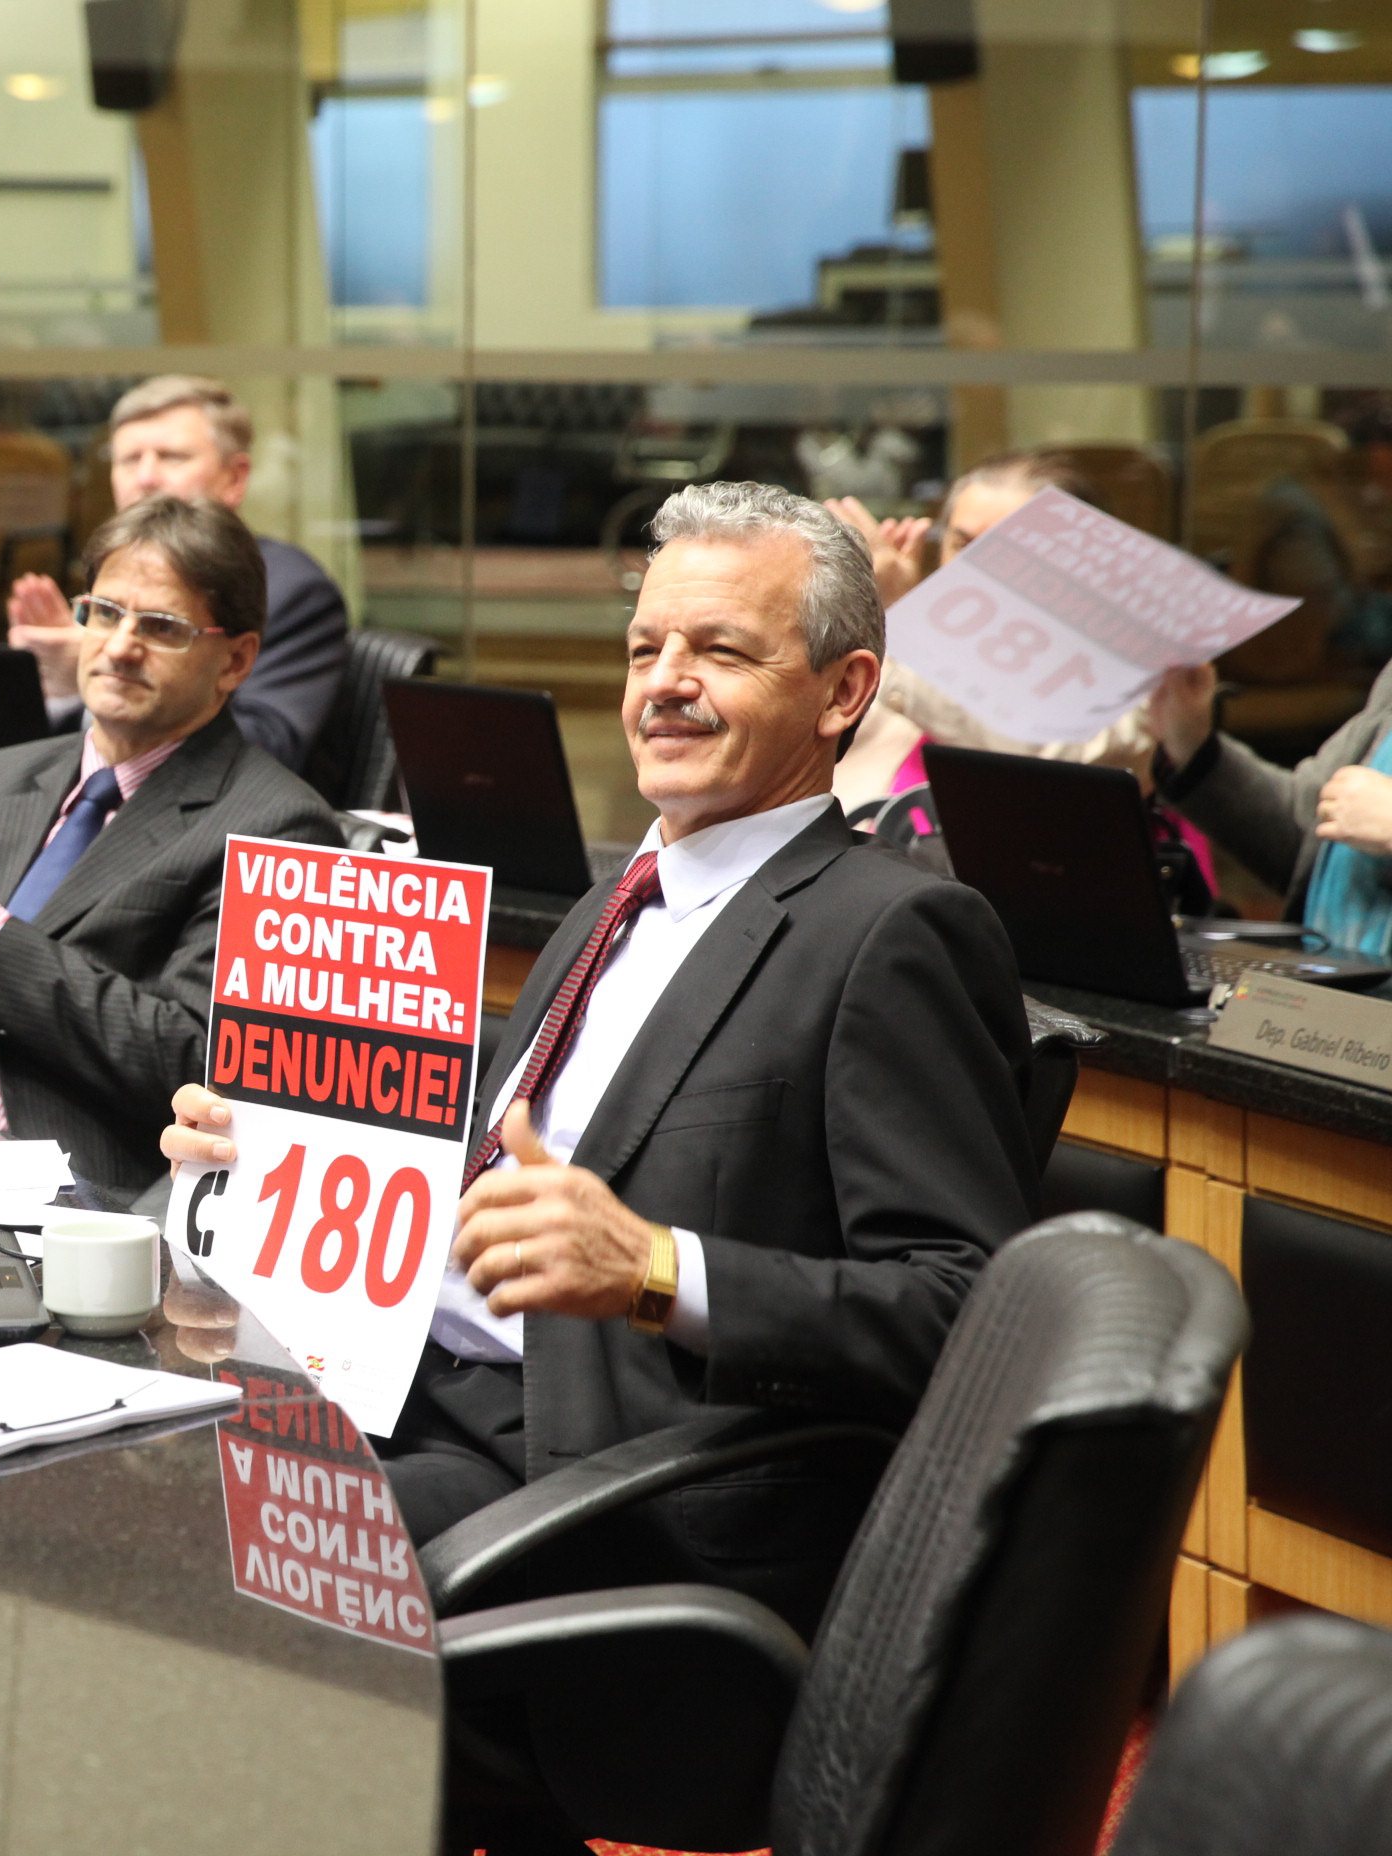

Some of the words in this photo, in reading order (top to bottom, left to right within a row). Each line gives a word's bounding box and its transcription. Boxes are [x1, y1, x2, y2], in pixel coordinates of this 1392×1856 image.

[237, 852, 471, 925] VIOLÊNCIA
[254, 908, 437, 976] CONTRA
[222, 956, 250, 1000] A
[261, 962, 465, 1035] MULHER:
[213, 1018, 462, 1126] DENUNCIE!
[1255, 1018, 1286, 1048] Dep.
[1290, 1027, 1343, 1058] Gabriel
[1340, 1038, 1391, 1071] Ribeiro
[252, 1143, 431, 1308] 180
